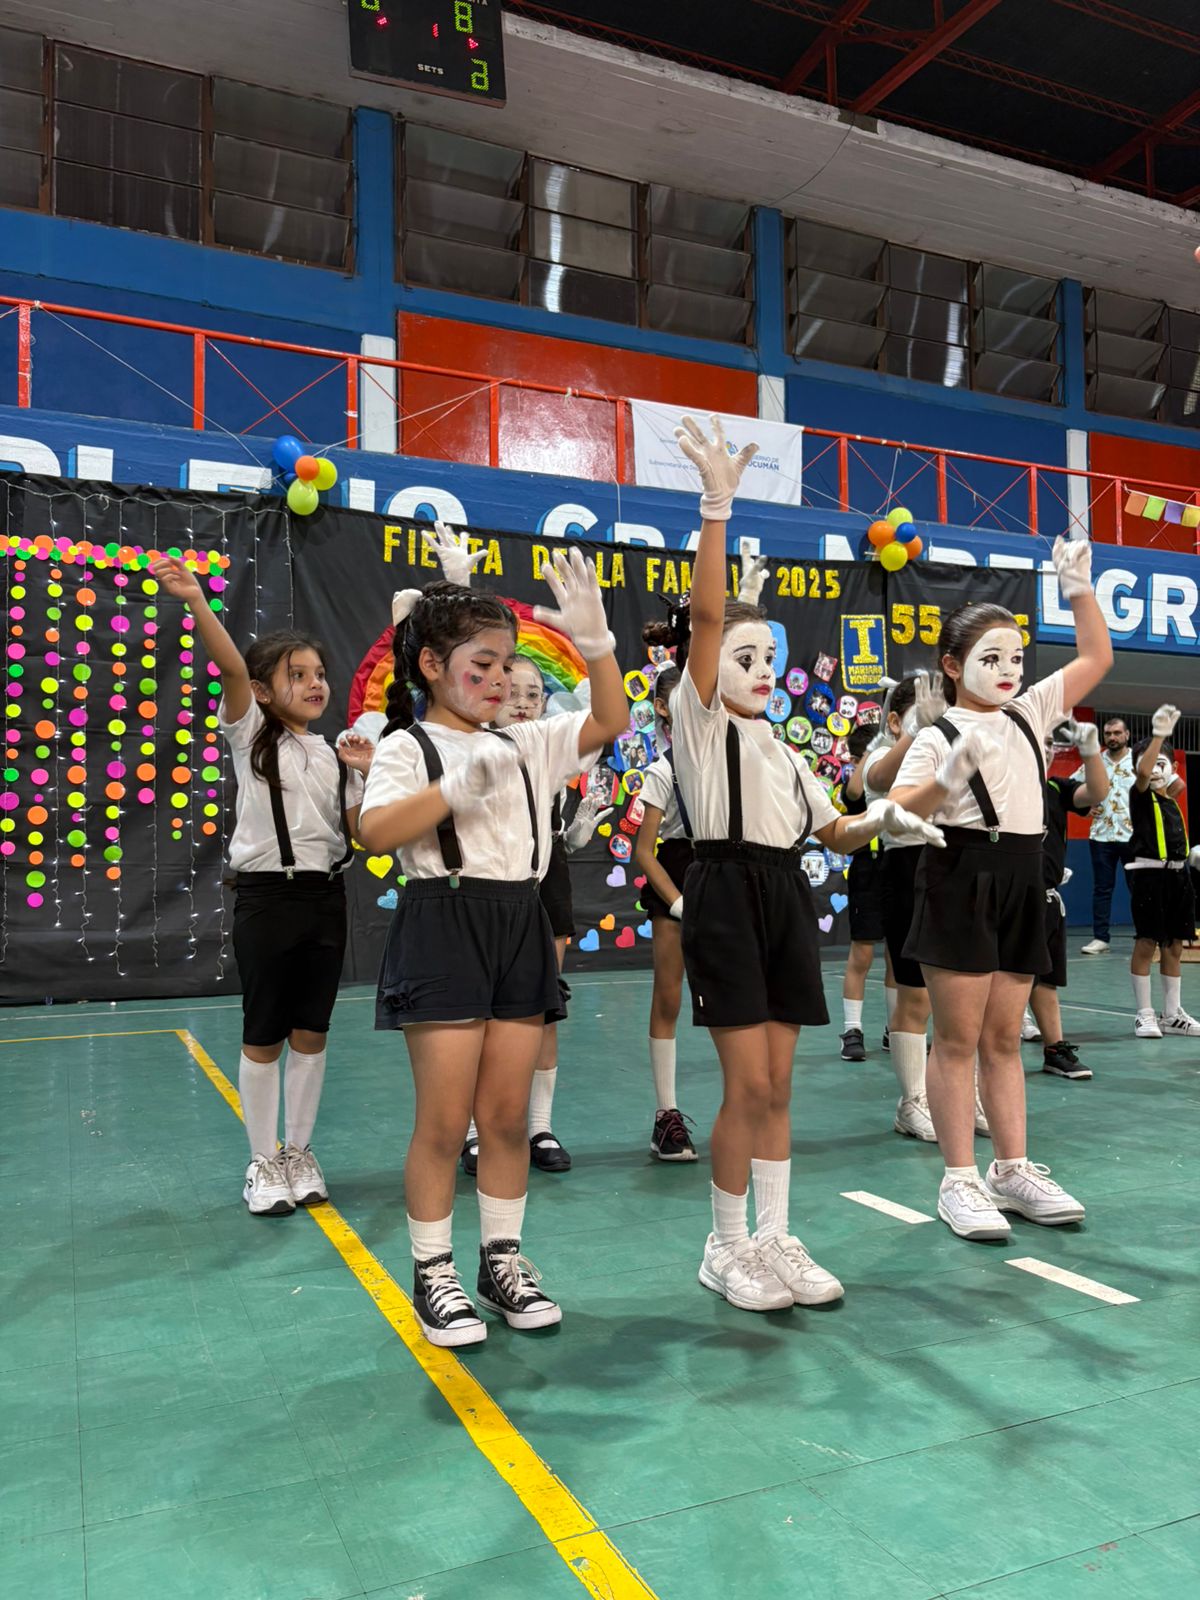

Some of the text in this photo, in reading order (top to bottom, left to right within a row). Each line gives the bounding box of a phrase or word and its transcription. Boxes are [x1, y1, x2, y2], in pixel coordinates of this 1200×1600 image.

[455, 1, 473, 33] 8
[417, 63, 444, 75] SETS
[384, 525, 503, 576] FIETA
[595, 551, 626, 588] LA
[776, 566, 841, 599] 2025
[891, 603, 942, 645] 55
